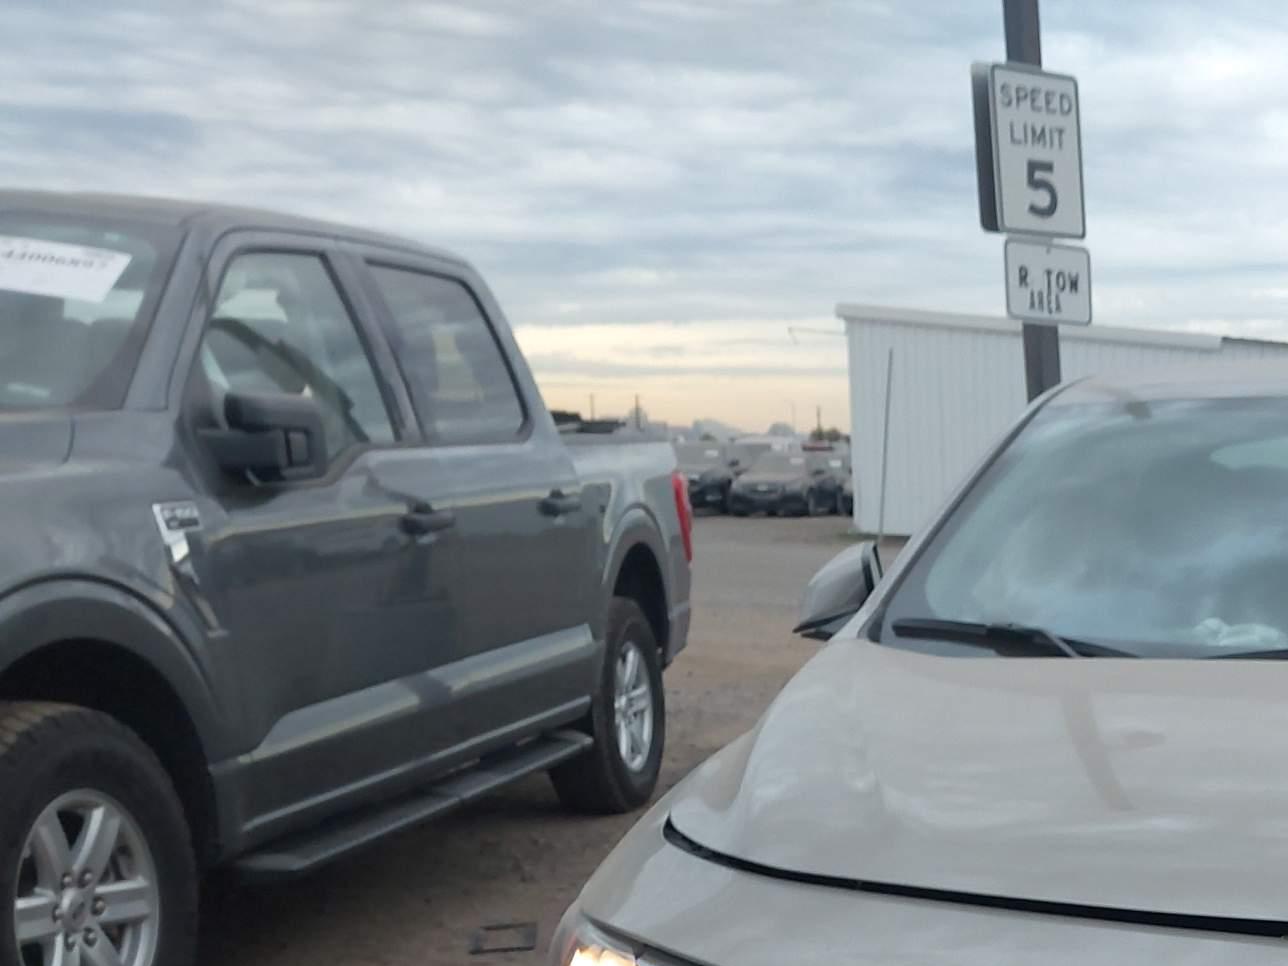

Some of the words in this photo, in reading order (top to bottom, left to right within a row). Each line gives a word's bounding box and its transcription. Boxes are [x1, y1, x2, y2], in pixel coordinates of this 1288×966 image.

[1000, 83, 1073, 116] SPEED
[1010, 122, 1066, 150] LIMIT
[1026, 159, 1059, 219] 5
[1045, 268, 1080, 294] TOW
